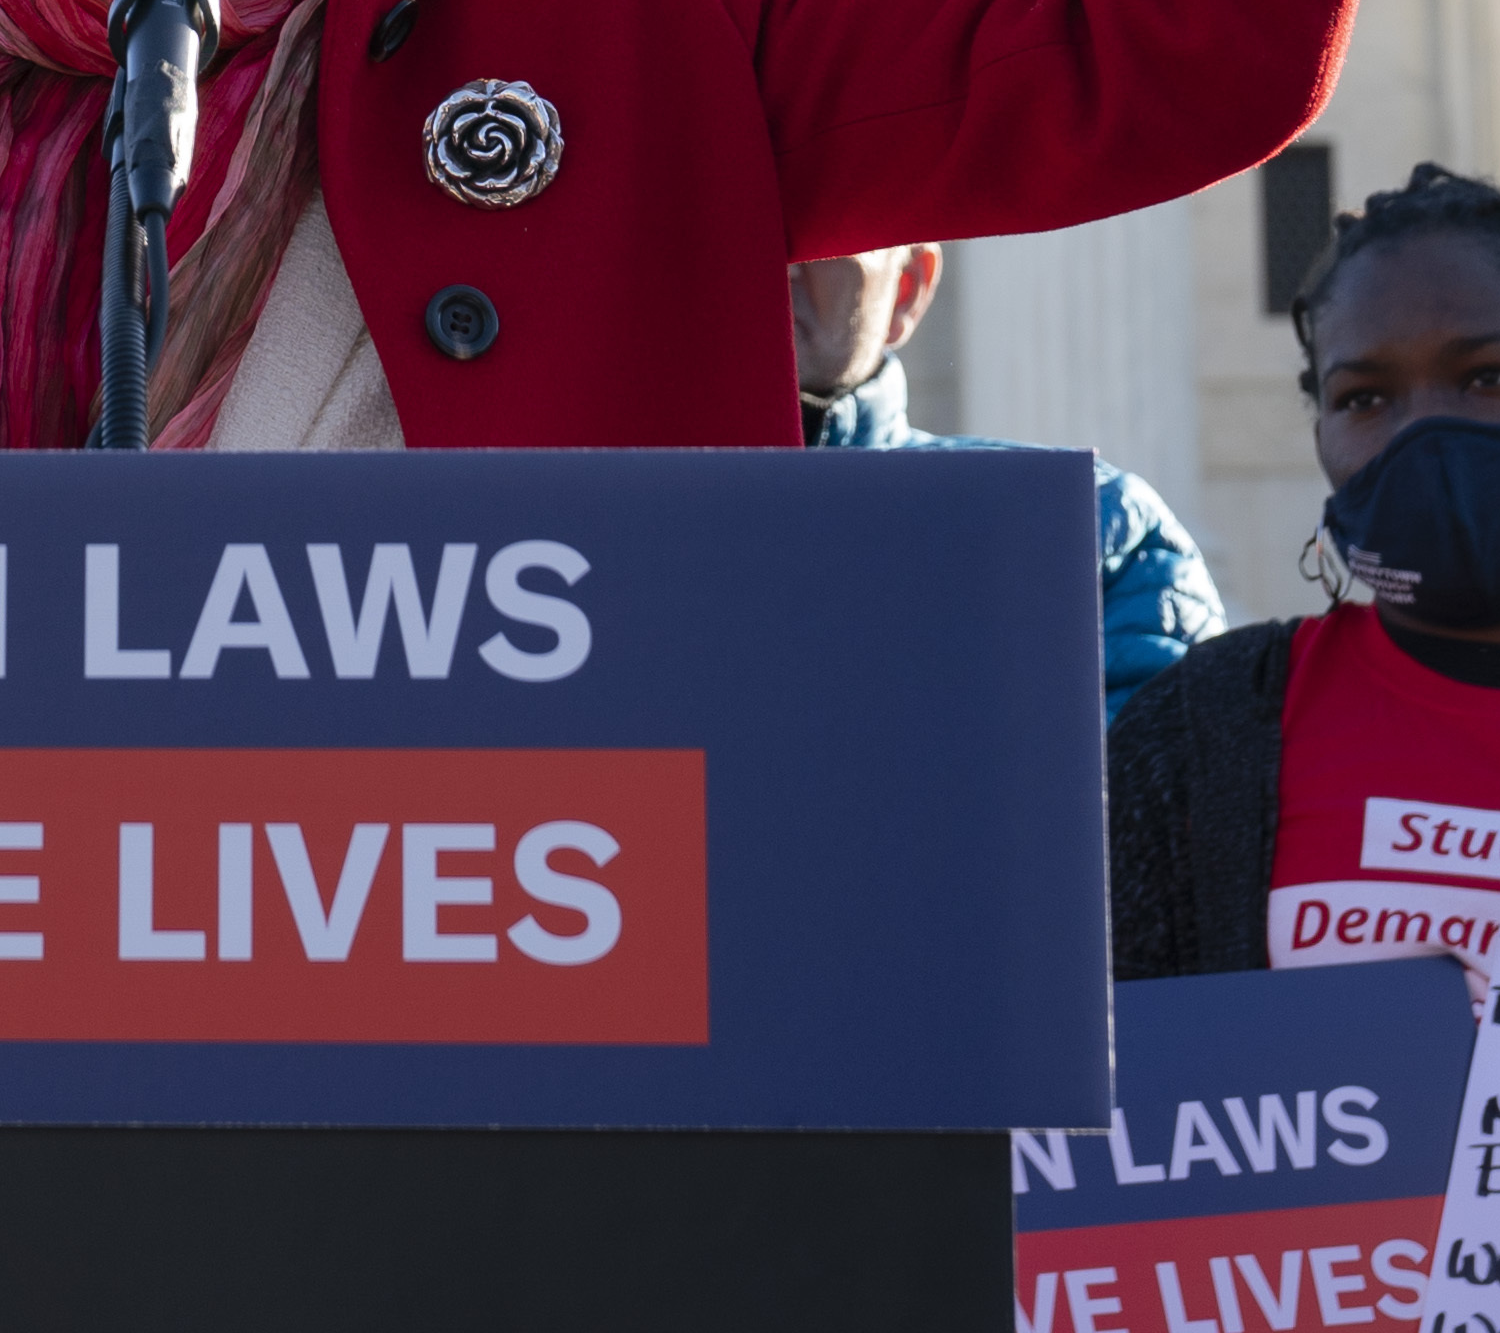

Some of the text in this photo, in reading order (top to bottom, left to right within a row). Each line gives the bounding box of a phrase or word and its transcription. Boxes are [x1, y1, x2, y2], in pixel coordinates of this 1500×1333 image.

[83, 539, 595, 683] LAWS
[117, 819, 623, 966] LIVES
[1108, 1085, 1390, 1186] LAWS
[1154, 1239, 1430, 1333] LIVES
